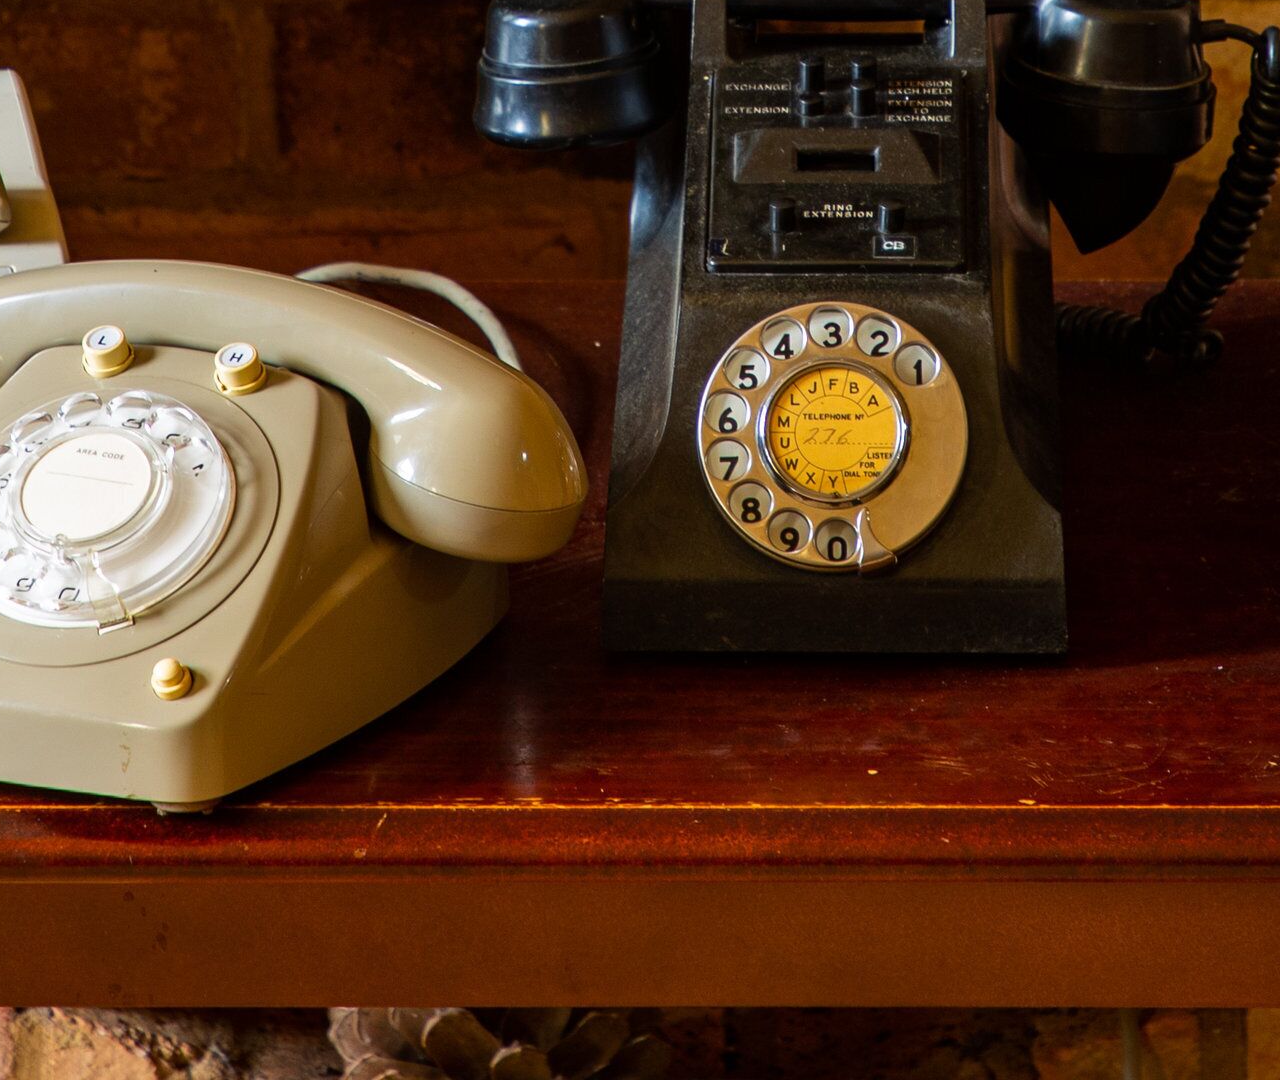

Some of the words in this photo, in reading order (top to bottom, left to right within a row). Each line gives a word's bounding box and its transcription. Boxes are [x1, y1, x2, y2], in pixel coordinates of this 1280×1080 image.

[914, 107, 929, 115] TO
[97, 335, 109, 346] L
[823, 323, 842, 348] 3
[774, 334, 794, 360] 4
[870, 330, 889, 357] 2
[229, 353, 243, 363] H
[739, 365, 758, 390] 5
[913, 359, 923, 385] 1
[808, 382, 817, 394] J
[829, 378, 838, 390] F
[849, 382, 859, 394] B
[790, 394, 800, 406] L
[867, 395, 879, 406] A
[719, 407, 738, 434] 6
[778, 416, 790, 427] M
[803, 427, 853, 445] 276
[780, 437, 790, 449] U
[76, 448, 97, 456] AREA
[102, 452, 125, 460] CODE
[720, 456, 739, 481] 7
[785, 458, 798, 470] W
[806, 472, 816, 485] X
[828, 476, 838, 489] Y
[741, 497, 761, 523] 8
[780, 527, 799, 552] 9
[827, 536, 847, 561] 0
